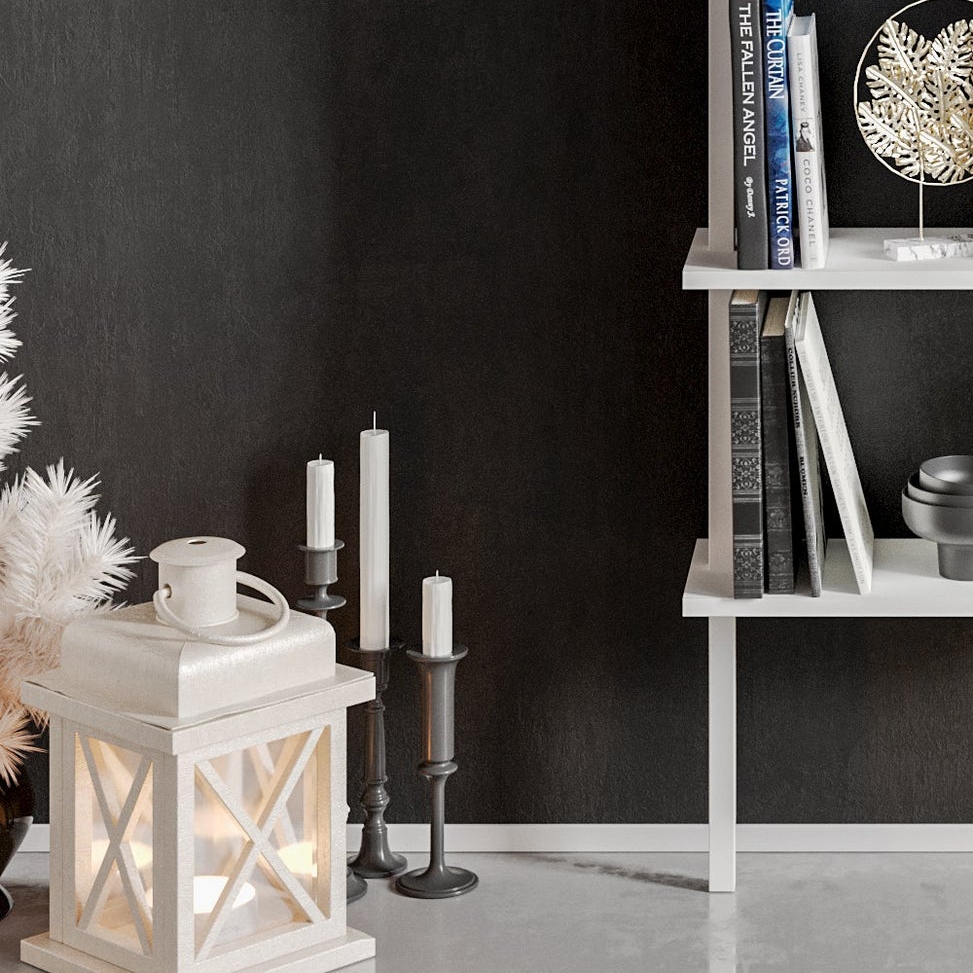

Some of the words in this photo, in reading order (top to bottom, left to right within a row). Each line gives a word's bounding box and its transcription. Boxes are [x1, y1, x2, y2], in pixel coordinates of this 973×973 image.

[738, 2, 753, 38] THE
[765, 8, 783, 37] THE
[740, 40, 755, 105] FALLEN
[767, 38, 786, 100] CURTAIN
[798, 75, 806, 113] CHANEY
[743, 108, 757, 167] ANGEL
[802, 158, 813, 195] COCO
[775, 178, 790, 234] PATRICK
[806, 198, 816, 248] CHANEL
[776, 236, 792, 266] ORD
[787, 347, 797, 388] COLLIER
[802, 369, 816, 403] SWEDISH
[814, 406, 828, 444] INTERIOR
[823, 446, 838, 475] DESIGN
